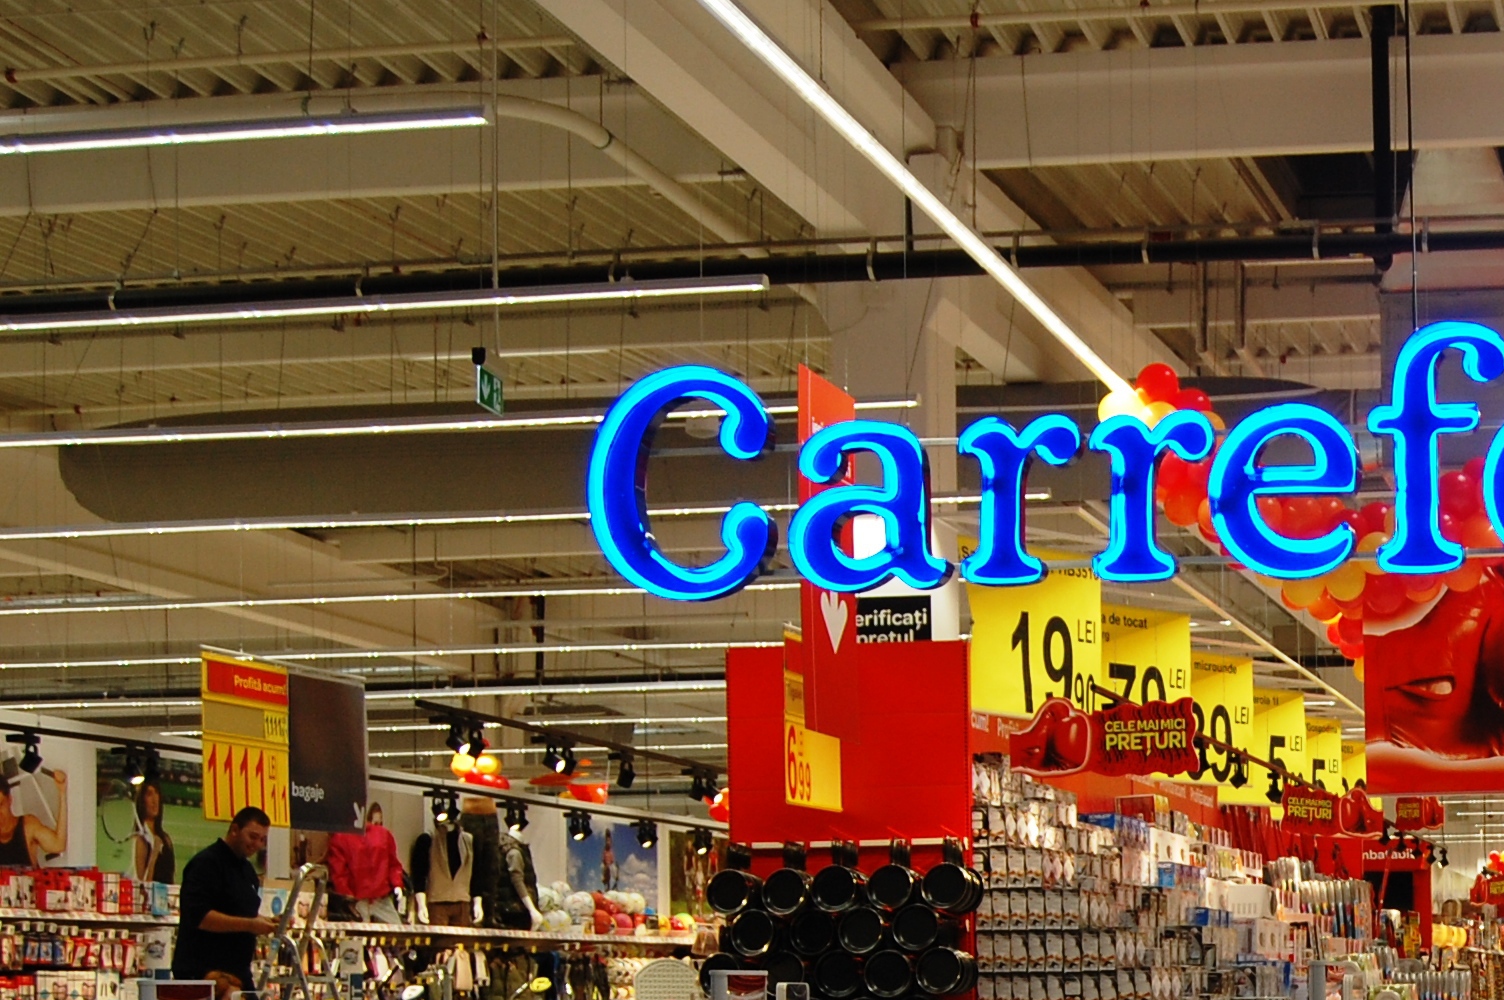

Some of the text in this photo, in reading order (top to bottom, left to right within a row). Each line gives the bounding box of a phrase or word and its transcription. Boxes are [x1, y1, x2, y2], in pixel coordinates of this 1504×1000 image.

[856, 608, 928, 630] erificați
[1123, 616, 1148, 630] tocat
[1011, 611, 1074, 714] 19
[1077, 619, 1096, 644] LEI
[1169, 667, 1186, 690] LEI
[1105, 718, 1186, 733] CELE MAI MICI
[1234, 706, 1249, 725] LEI
[1105, 731, 1187, 757] PREȚURI
[1289, 735, 1303, 752] LEI
[788, 725, 797, 800] 6
[291, 781, 325, 802] bagaje
[1287, 805, 1332, 821] PREȚURI
